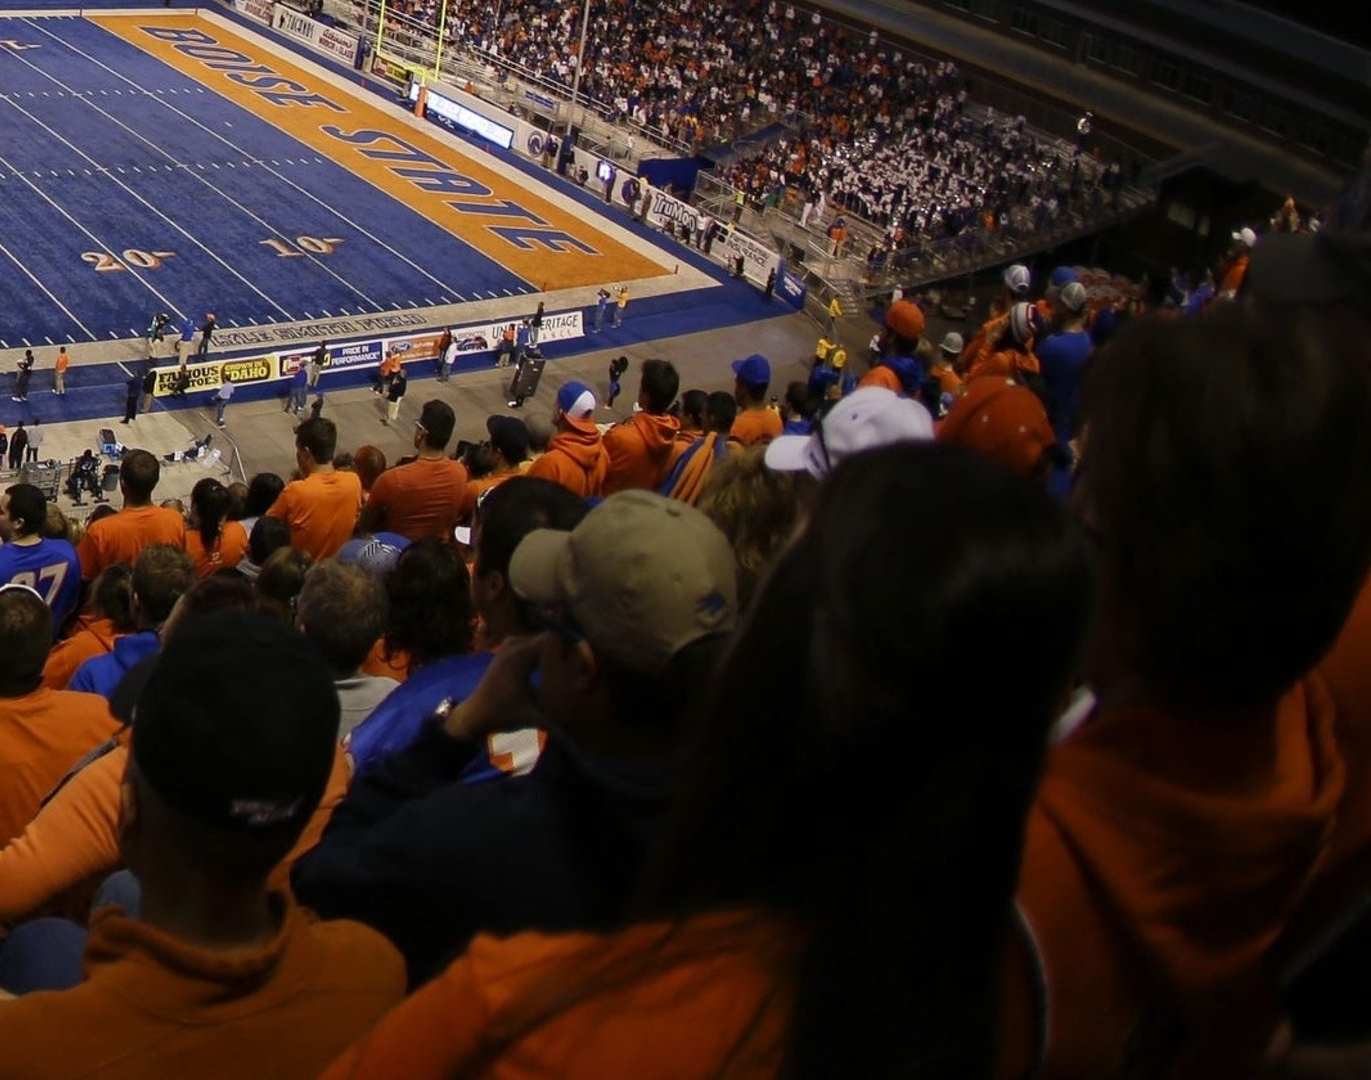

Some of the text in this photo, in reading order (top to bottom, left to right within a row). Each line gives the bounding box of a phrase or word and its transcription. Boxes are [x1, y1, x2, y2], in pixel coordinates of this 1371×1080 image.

[135, 24, 603, 258] BOISE STATE
[80, 248, 162, 272] 20
[258, 235, 334, 258] 10
[209, 313, 427, 348] LYLE SMITH FIELD
